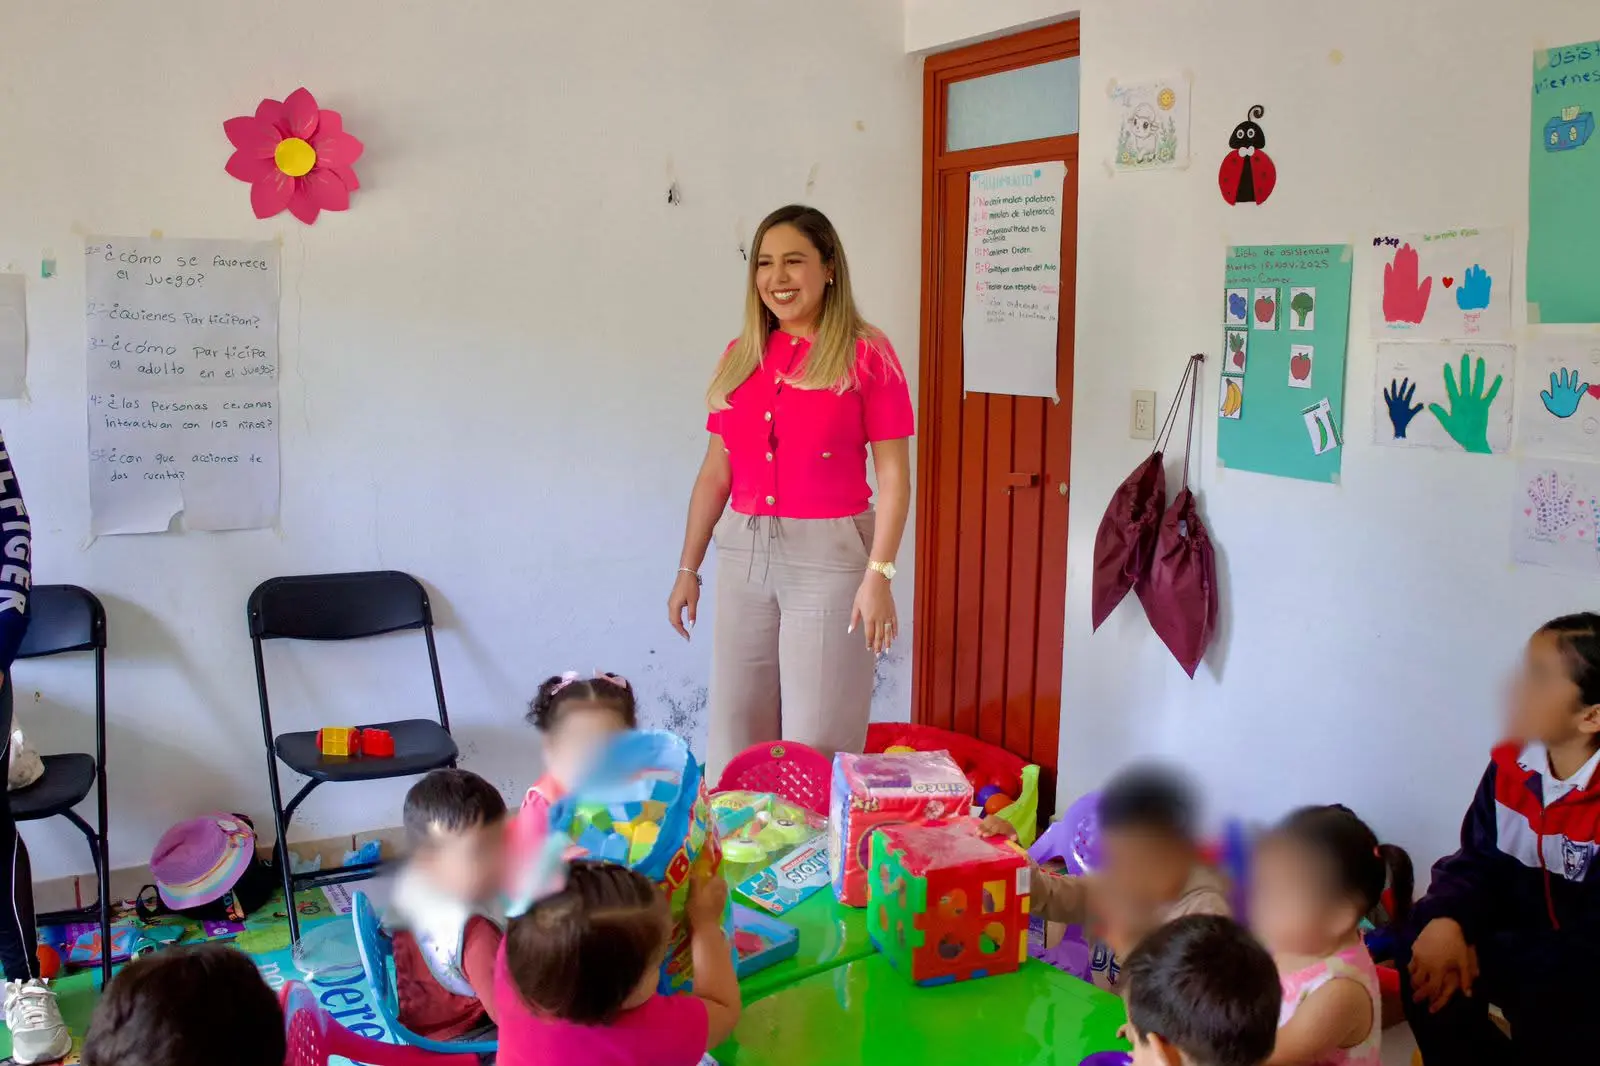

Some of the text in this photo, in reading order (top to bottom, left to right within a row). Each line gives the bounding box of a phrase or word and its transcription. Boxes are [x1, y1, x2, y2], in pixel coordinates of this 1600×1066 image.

[1263, 248, 1275, 257] de
[1280, 247, 1330, 257] asistencia
[177, 256, 198, 267] se
[213, 254, 268, 271] favorece
[117, 269, 129, 280] el
[110, 360, 121, 370] el
[138, 362, 184, 374] adulto
[200, 369, 215, 378] en
[225, 367, 235, 378] el
[211, 420, 228, 429] los
[155, 453, 175, 464] que
[192, 453, 239, 462] acciones
[143, 469, 185, 481] cuenta?
